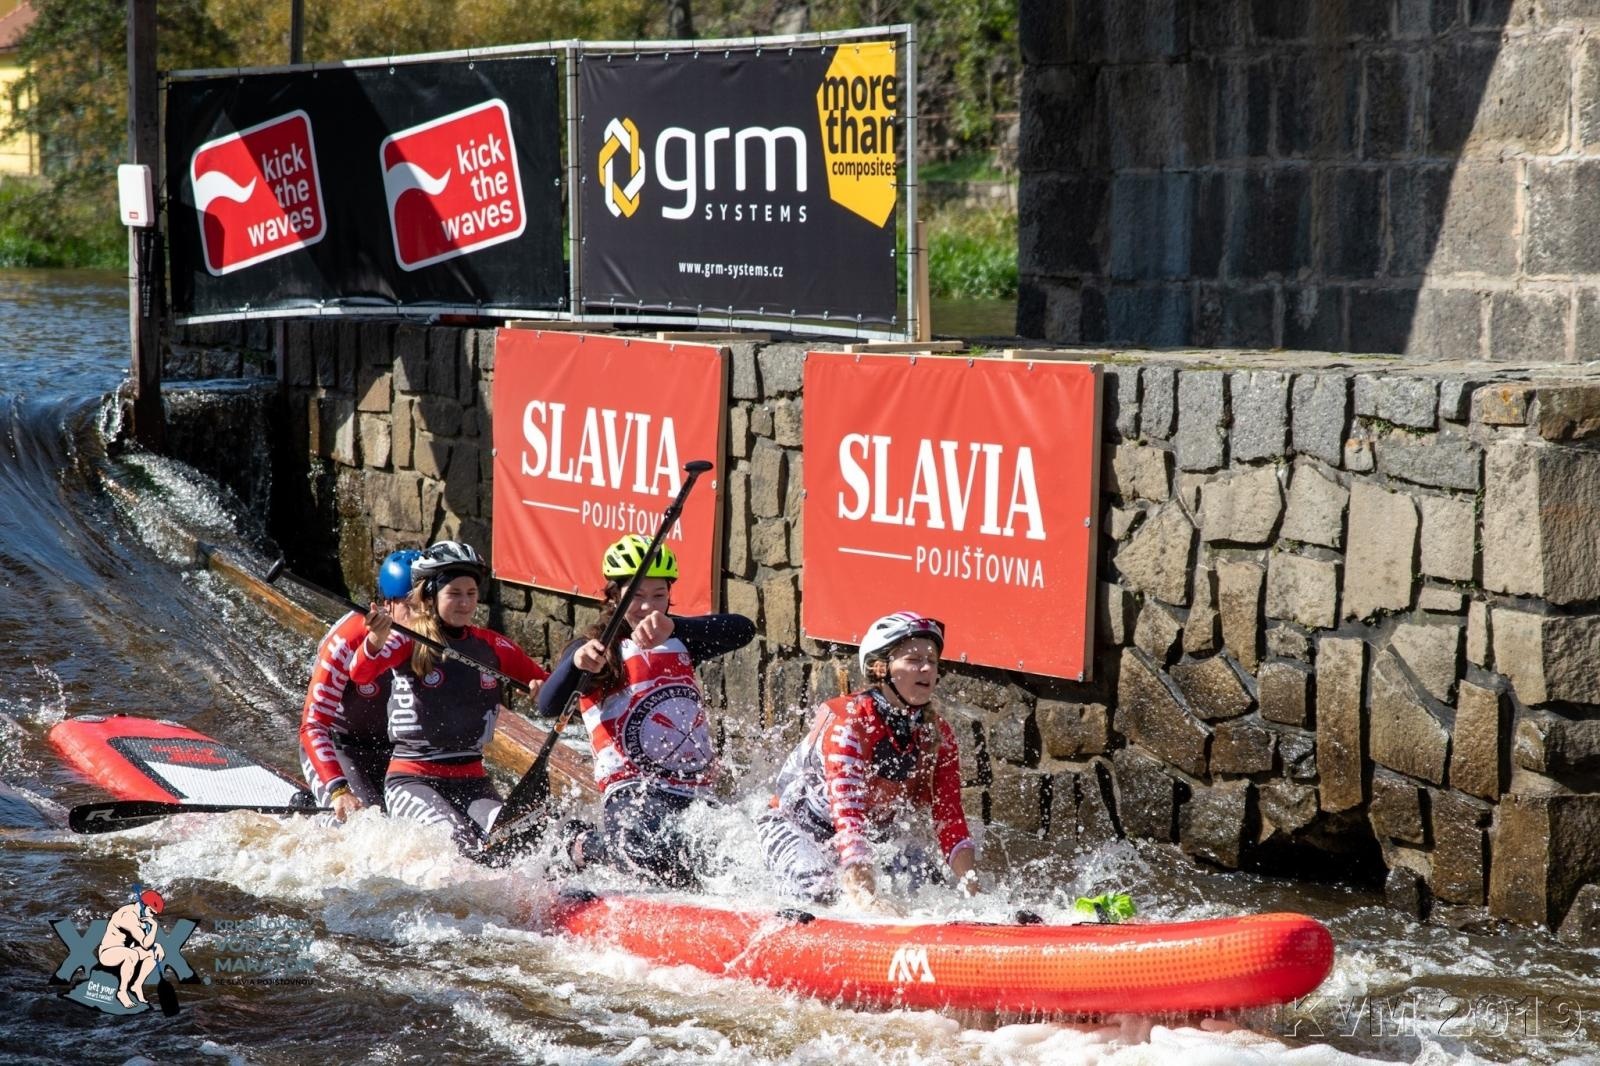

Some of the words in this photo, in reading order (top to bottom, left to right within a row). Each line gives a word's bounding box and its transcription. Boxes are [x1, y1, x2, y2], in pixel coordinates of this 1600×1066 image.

[823, 74, 896, 111] more
[826, 107, 896, 154] than
[262, 142, 306, 182] kick
[456, 133, 505, 174] kick
[655, 126, 807, 220] grm
[832, 157, 896, 181] composites
[274, 178, 310, 210] the
[470, 170, 509, 202] the
[247, 204, 314, 247] waves
[441, 199, 514, 242] waves
[705, 203, 807, 222] SYSTEMS
[679, 261, 784, 278] www.grm-systems.cz
[521, 400, 682, 498] SLAVIA
[838, 433, 1046, 540] SLAVIA
[582, 500, 682, 541] POJIŠŤOVA
[916, 545, 1044, 588] POJIŠŤOVNA
